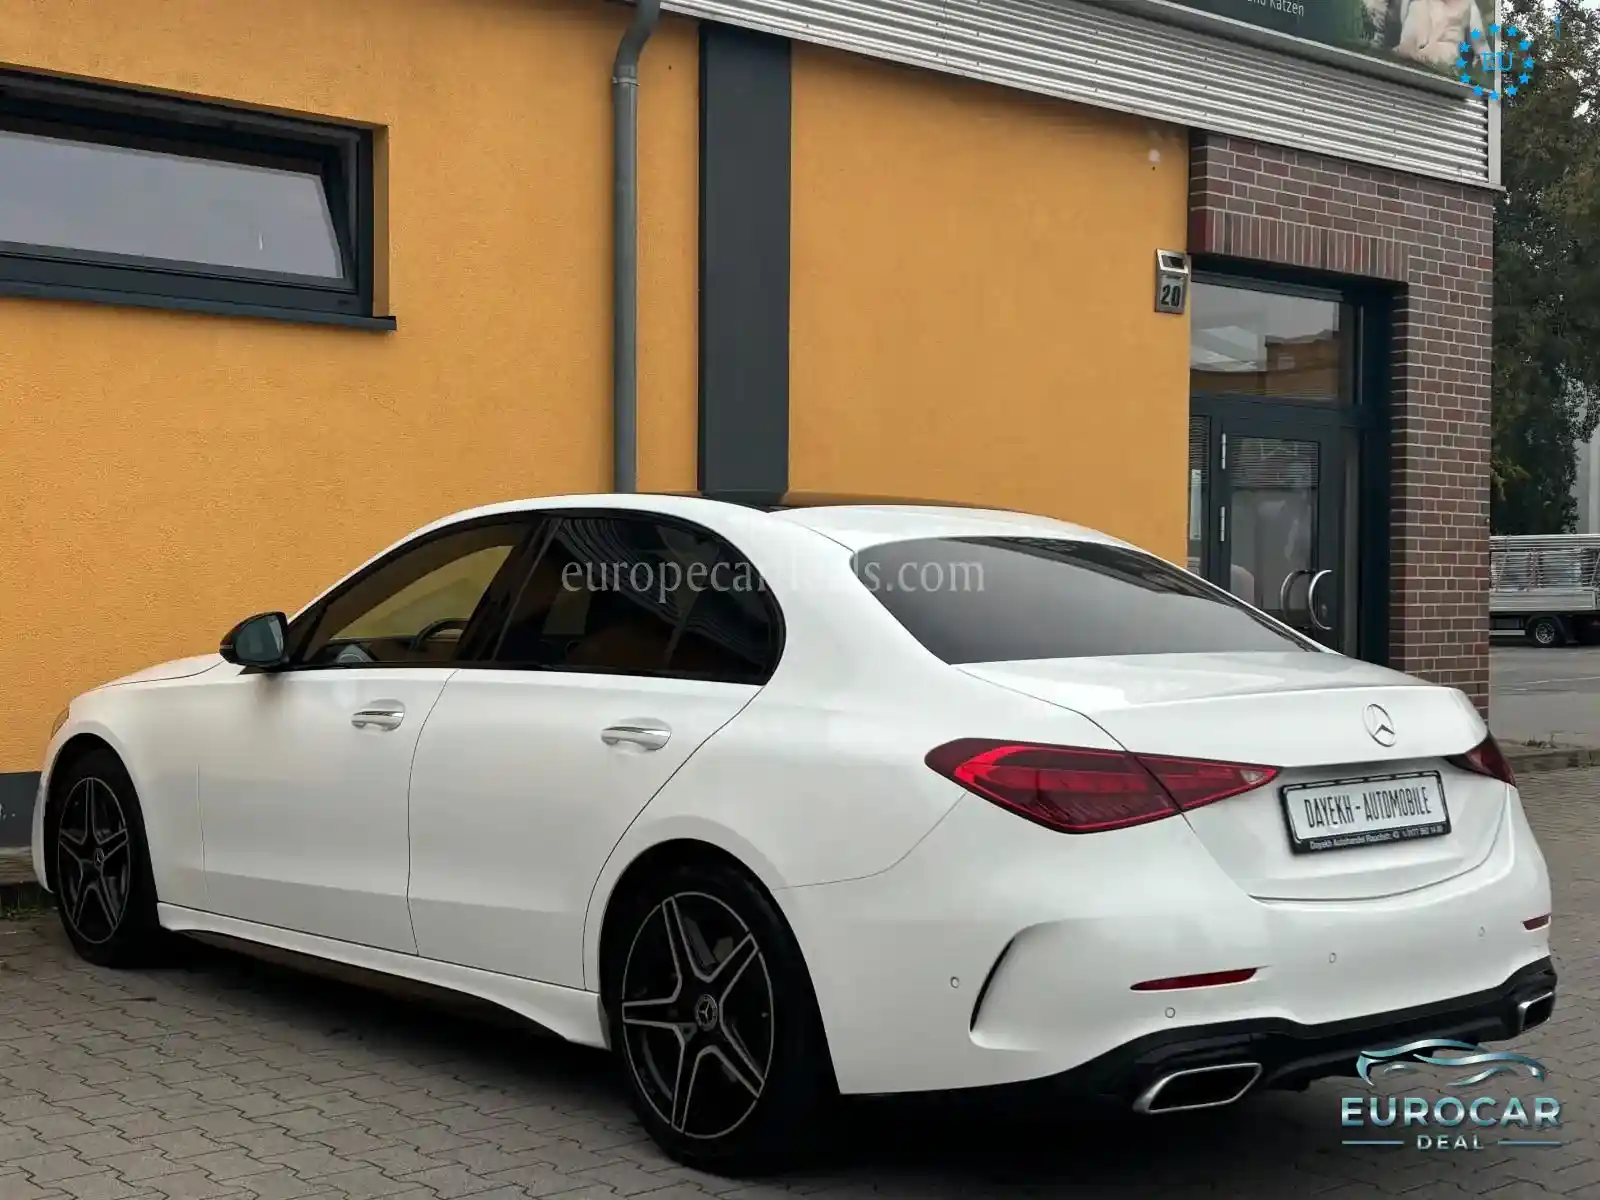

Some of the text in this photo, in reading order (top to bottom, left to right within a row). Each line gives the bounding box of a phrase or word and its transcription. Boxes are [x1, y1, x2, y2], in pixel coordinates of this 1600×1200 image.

[1270, 0, 1305, 17] Katzen
[1161, 284, 1180, 307] 20
[1304, 795, 1355, 828] DAYEKH
[1362, 786, 1432, 822] AUTOMOBILE
